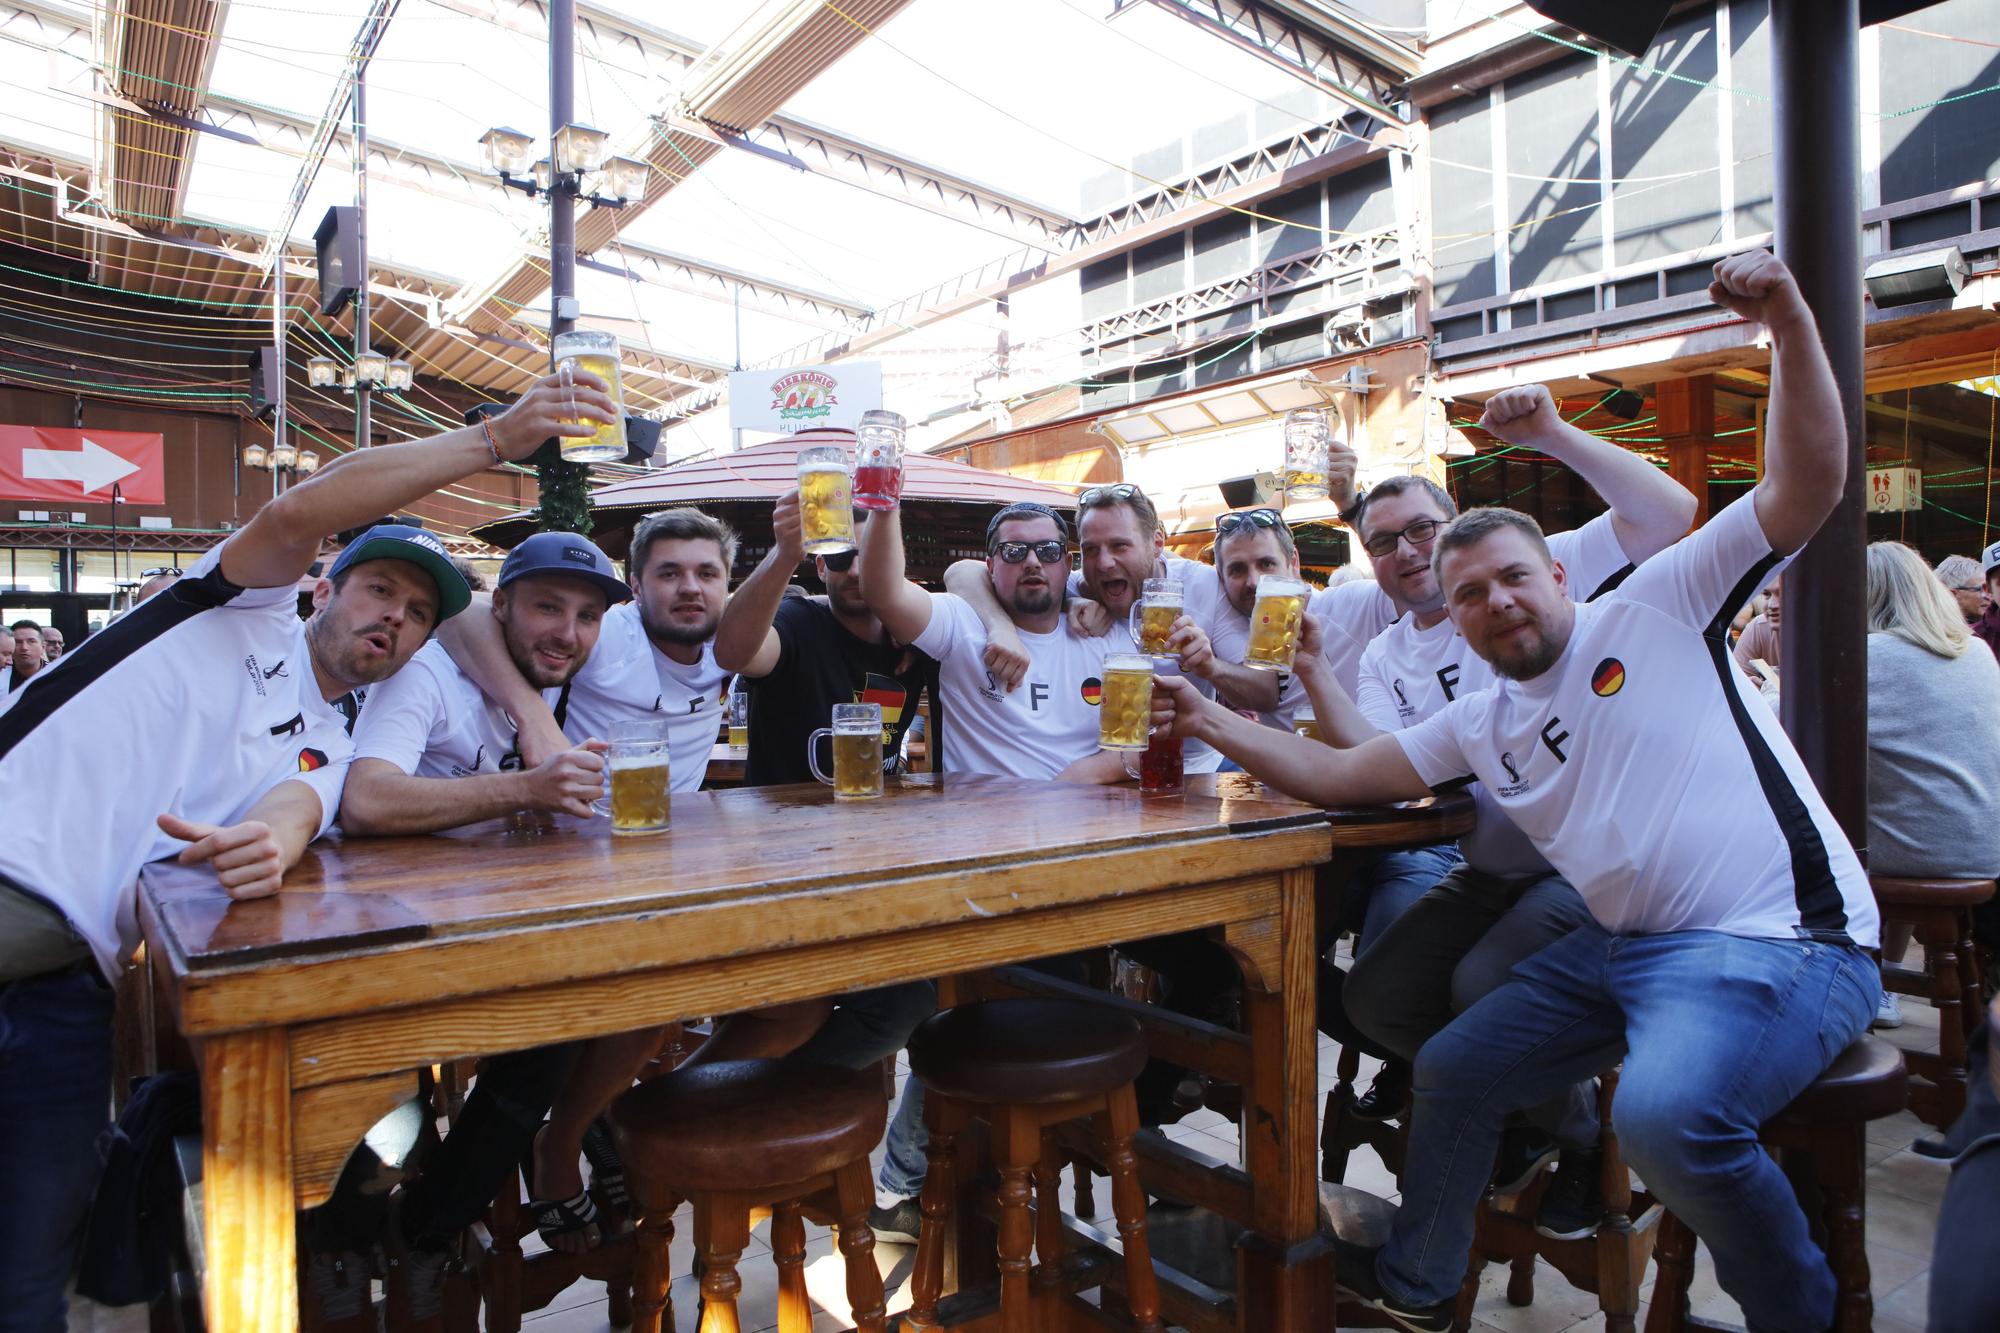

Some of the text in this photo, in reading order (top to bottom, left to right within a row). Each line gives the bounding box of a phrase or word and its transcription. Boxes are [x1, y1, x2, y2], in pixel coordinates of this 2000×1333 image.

[773, 371, 834, 394] BIERKÖNIG
[1030, 683, 1049, 711] F
[1436, 663, 1460, 703] F
[1541, 716, 1570, 764] F
